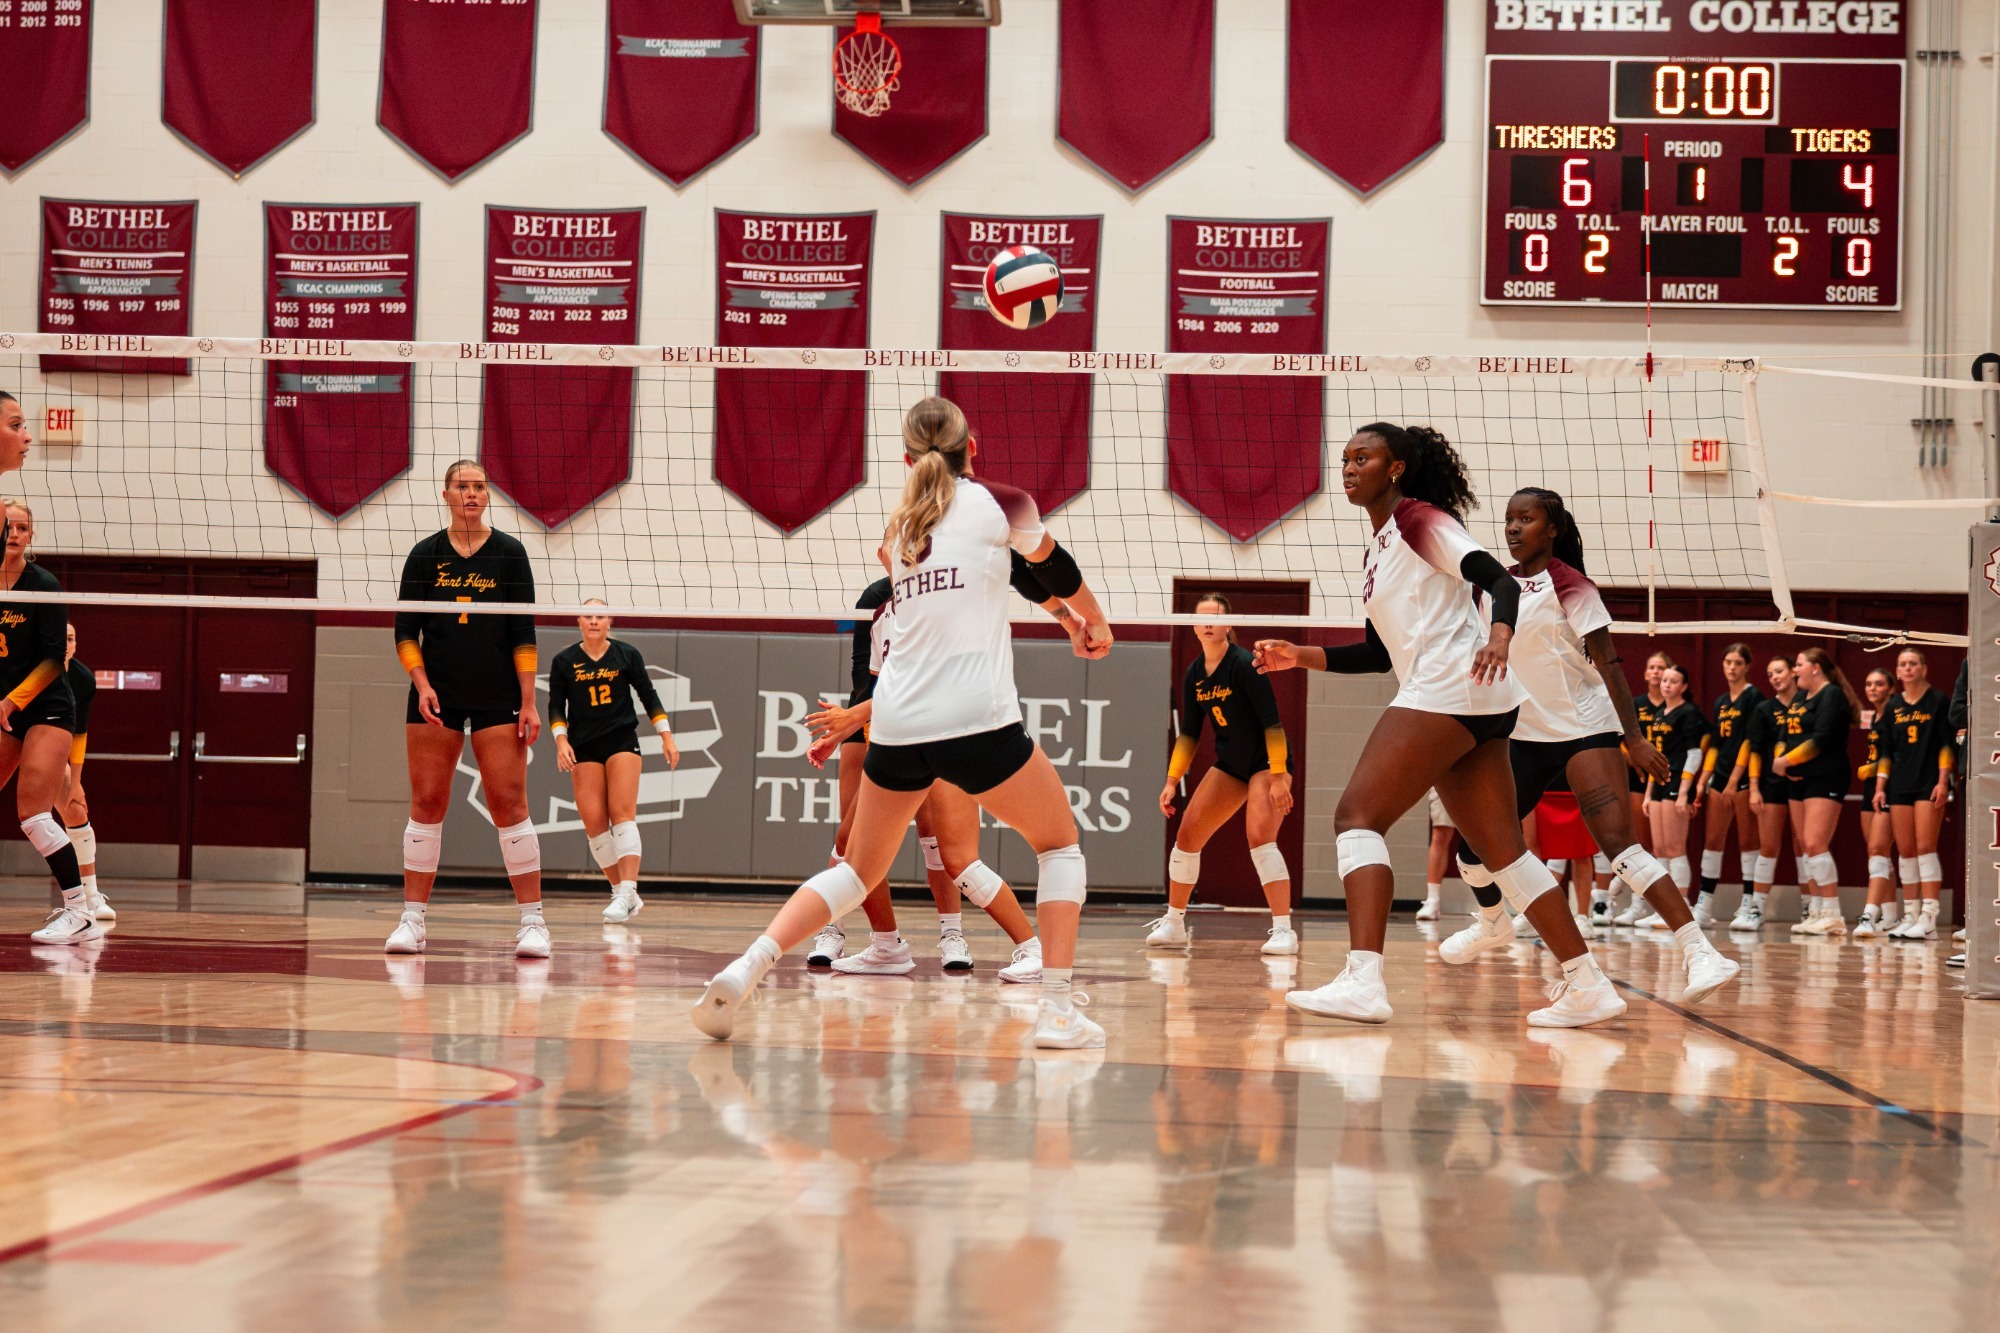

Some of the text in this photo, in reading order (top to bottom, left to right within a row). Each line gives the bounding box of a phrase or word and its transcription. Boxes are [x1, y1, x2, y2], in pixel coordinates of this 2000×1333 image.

[0, 1, 12, 12] 05
[20, 1, 48, 12] 2008
[0, 15, 81, 28] 11 2012 2013
[1494, 0, 1899, 34] BETHEL COLLEGE
[1655, 65, 1770, 116] 0:00
[1495, 125, 1616, 150] THRESHERS
[1792, 128, 1871, 153] TIGERS
[1664, 141, 1722, 158] PERIOD
[1563, 158, 1592, 207] 6
[1695, 167, 1706, 201] 1
[1843, 164, 1873, 208] 4
[68, 207, 170, 229] BETHEL
[291, 211, 392, 232] BETHEL
[513, 215, 617, 238] BETHEL
[1505, 213, 1557, 231] FOULS
[1576, 214, 1620, 232] T.O.L.
[1640, 215, 1747, 233] PLAYER FOUL
[1765, 217, 1810, 234] T.O.L.
[1827, 218, 1881, 235] FOULS
[67, 230, 168, 249] COLLEGE
[743, 219, 848, 242] BETHEL
[969, 221, 1075, 244] BETHEL
[1196, 226, 1303, 248] BETHEL
[291, 234, 391, 251] COLLEGE
[512, 238, 616, 258] COLLEGE
[742, 243, 846, 262] COLLEGE
[1196, 250, 1301, 268] COLLEGE
[1525, 233, 1549, 273] 0
[1584, 234, 1610, 273] 2
[1773, 237, 1799, 276] 2
[1847, 238, 1871, 277] 0
[80, 258, 153, 269] MEN'S TENNIS
[291, 261, 390, 272] MEN'S BASKETBALL
[512, 266, 614, 278] MEN'S BASKETBALL
[80, 277, 150, 287] NAIA POSTSEASON
[743, 270, 845, 282] MEN'S BASKETBALL
[1220, 278, 1275, 290] FOOTBALL
[87, 286, 142, 295] APPEARANCES
[296, 283, 383, 294] KCAC CHAMPIONS
[526, 286, 598, 296] NAIA POSTSEASON
[1503, 281, 1556, 297] SCORE
[1661, 283, 1719, 301] MATCH
[1826, 285, 1878, 303] SCORE
[49, 298, 180, 312] 1995 1996 1997 1998
[275, 302, 406, 314] 1955 1956 1973 1999
[533, 296, 589, 304] APPEARANCES
[769, 300, 817, 309] CHAMPIONS
[1210, 298, 1284, 308] NAIA POSTSEASON
[48, 313, 75, 325] 1999
[493, 306, 628, 321] 2003 2021 2022 2023
[724, 311, 787, 325] 2021 2022
[1218, 307, 1276, 316] APPEARANCES
[274, 316, 334, 328] 2003 2021
[492, 322, 519, 335] 2025
[1177, 319, 1279, 333] 1984 2006 2020
[61, 335, 152, 352] BETHEL
[260, 339, 352, 356] BETHEL
[459, 343, 553, 360] BETHEL
[661, 346, 755, 364] BETHEL
[864, 350, 958, 368] BETHEL
[1067, 352, 1163, 370] BETHEL
[1272, 354, 1368, 372] BETHEL
[1478, 356, 1573, 374] BETHEL
[274, 395, 297, 407] 2021
[47, 408, 75, 431] EXIT
[1692, 440, 1722, 463] EXIT
[435, 572, 497, 593] Fort Hays
[456, 596, 472, 624] 7
[575, 668, 620, 682] Fort Hays
[588, 684, 612, 706] 12
[1196, 685, 1232, 701] Fort Hays
[1211, 705, 1228, 727] 8
[1894, 711, 1932, 725] Fort Hays
[1906, 725, 1919, 743] 9
